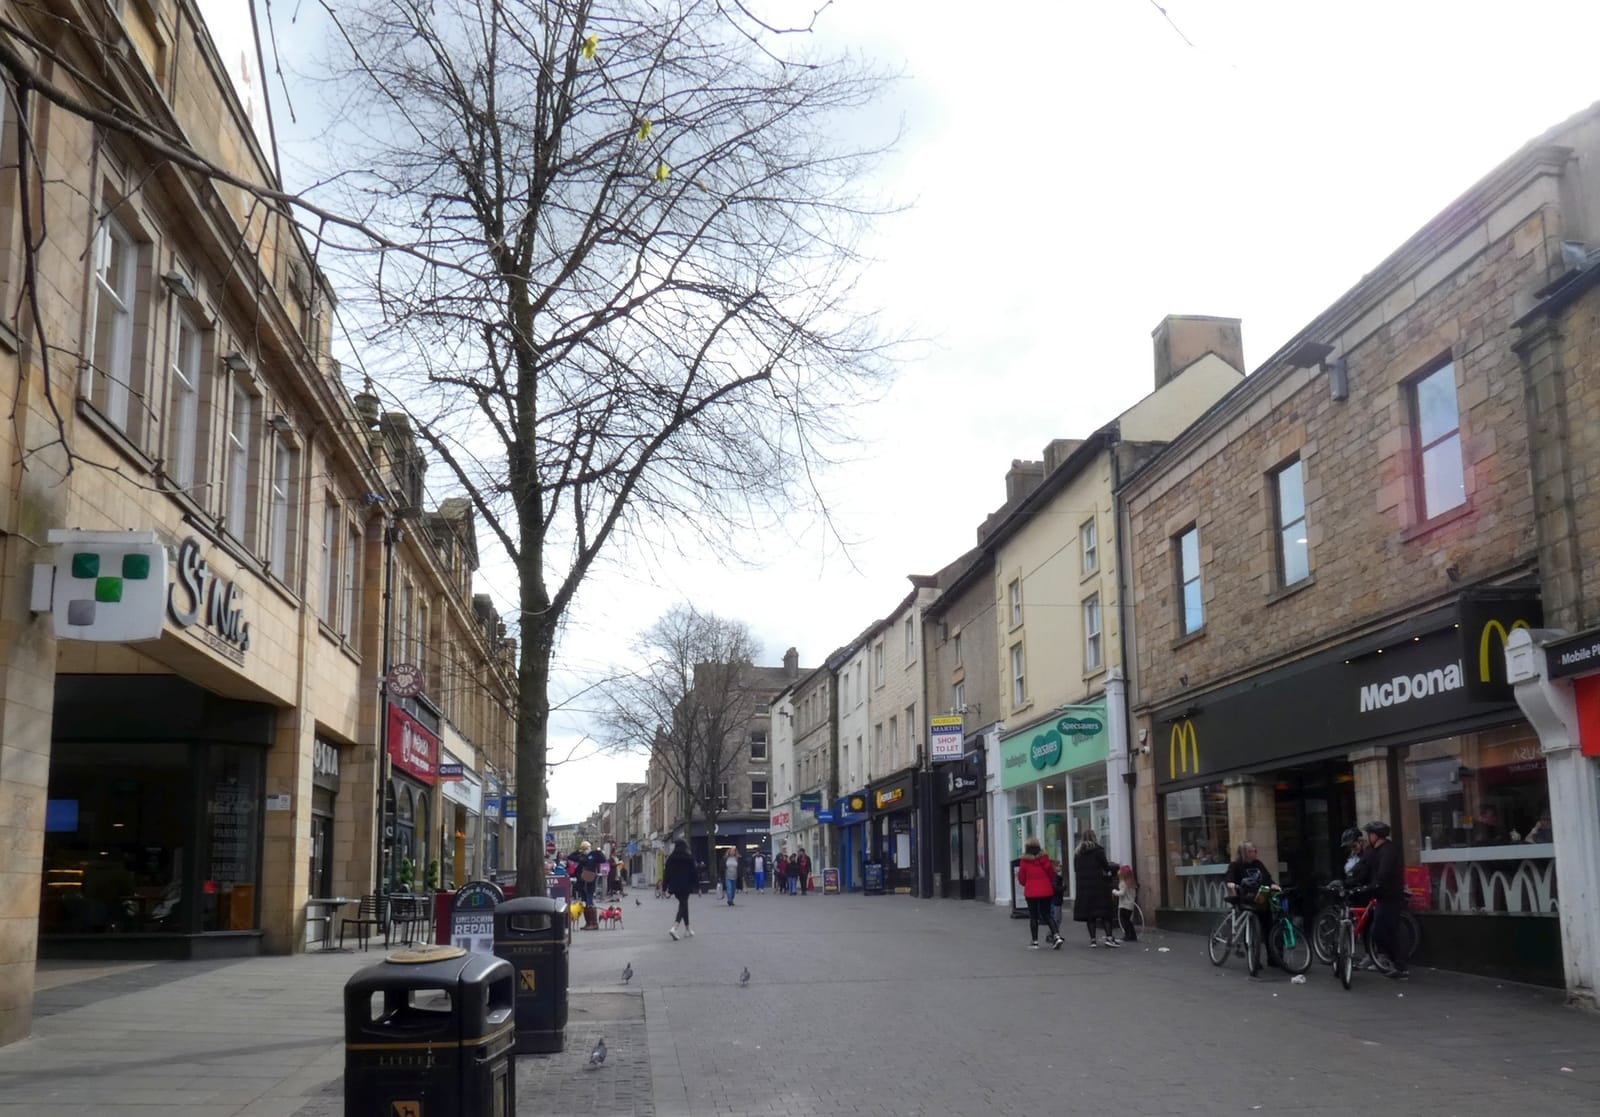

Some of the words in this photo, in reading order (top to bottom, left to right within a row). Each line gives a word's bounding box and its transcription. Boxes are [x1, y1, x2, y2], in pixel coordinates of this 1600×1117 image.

[1561, 648, 1591, 665] Mobile
[393, 666, 416, 676] COSTA
[391, 682, 418, 694] COFFEE
[1061, 721, 1099, 732] Specsavers
[937, 736, 957, 744] SHOP
[935, 745, 946, 753] TO
[946, 744, 959, 752] LET
[1032, 741, 1058, 760] Specsavers
